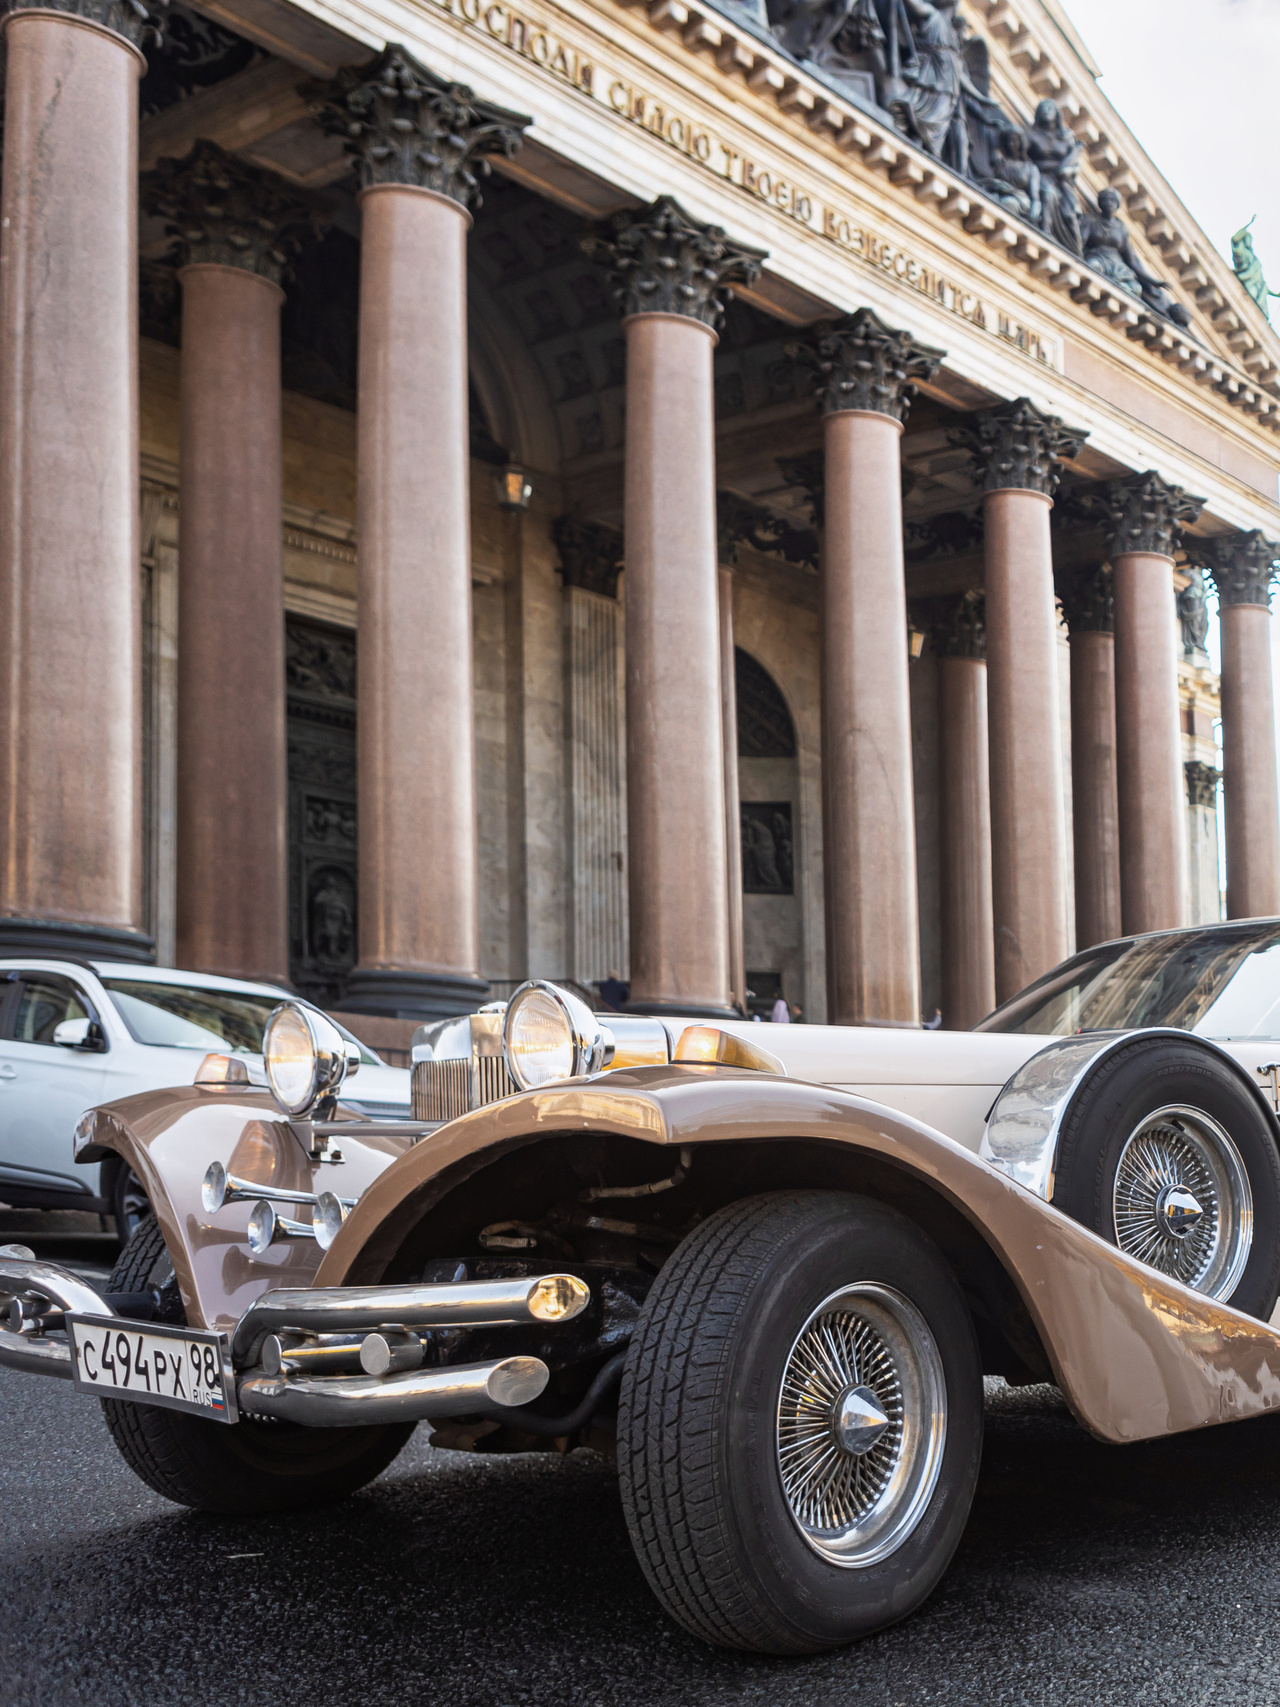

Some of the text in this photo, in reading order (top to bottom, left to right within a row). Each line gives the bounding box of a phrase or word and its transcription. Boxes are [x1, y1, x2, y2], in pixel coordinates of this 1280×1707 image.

[720, 143, 812, 222] ТВОЕЮ
[190, 1343, 217, 1390] 98
[193, 1389, 212, 1407] RUS
